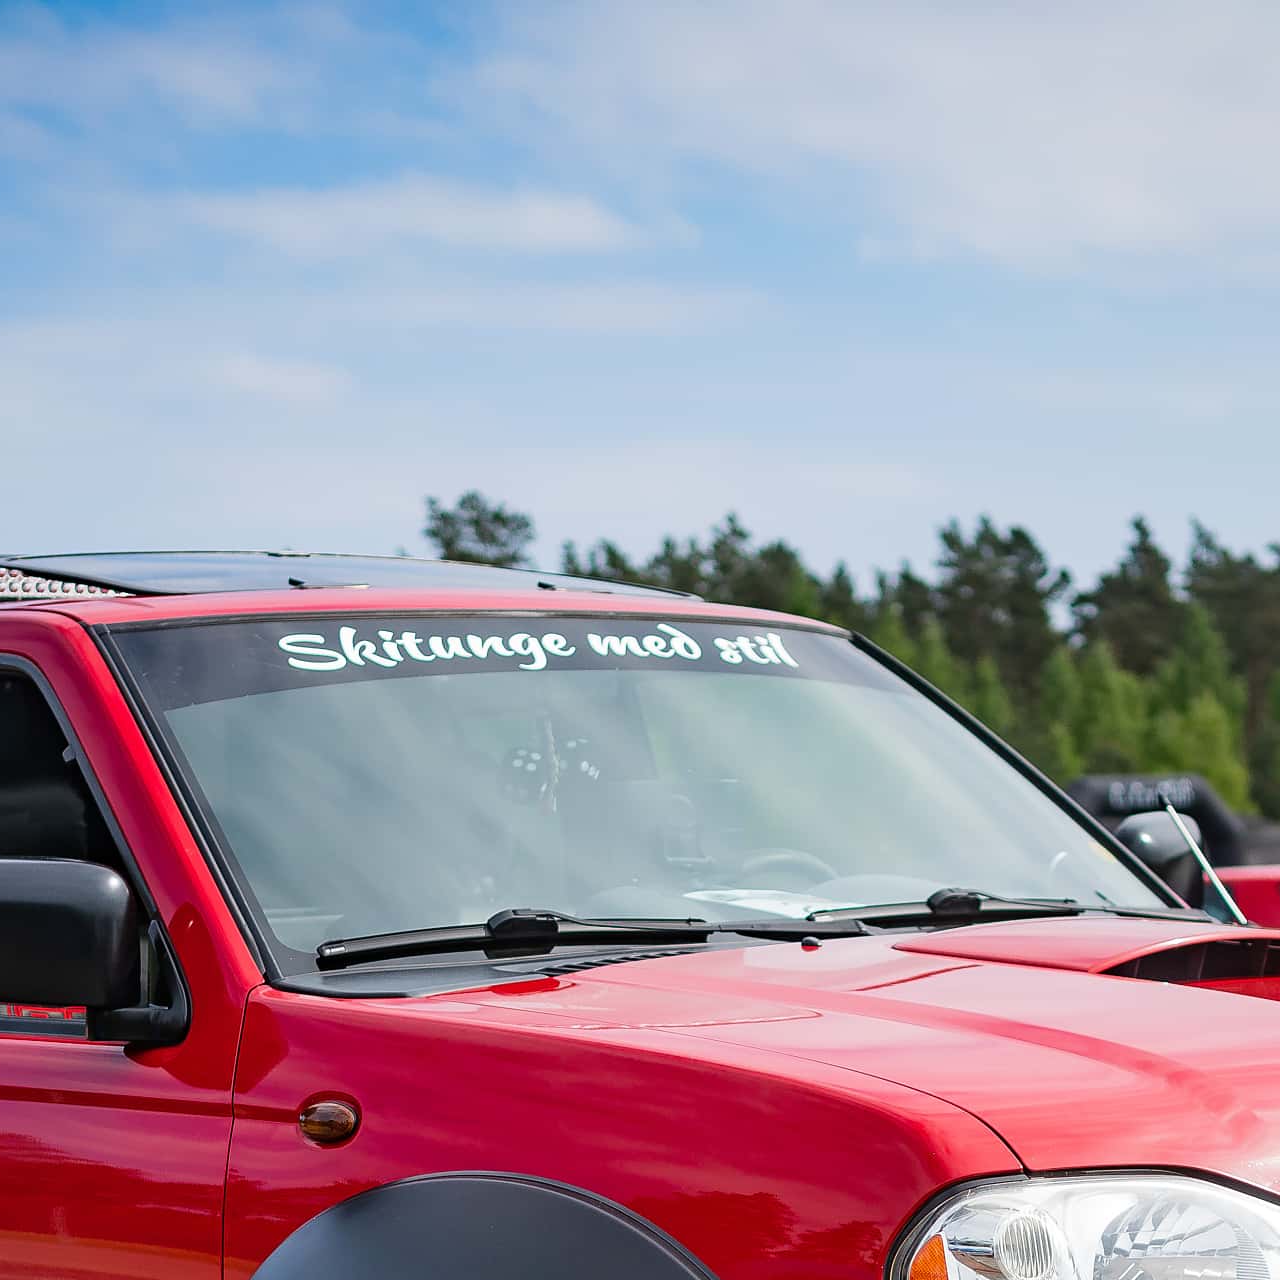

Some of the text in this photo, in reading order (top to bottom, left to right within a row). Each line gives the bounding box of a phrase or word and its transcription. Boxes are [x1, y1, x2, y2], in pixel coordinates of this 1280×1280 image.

[278, 624, 800, 670] Skitunge med stil
